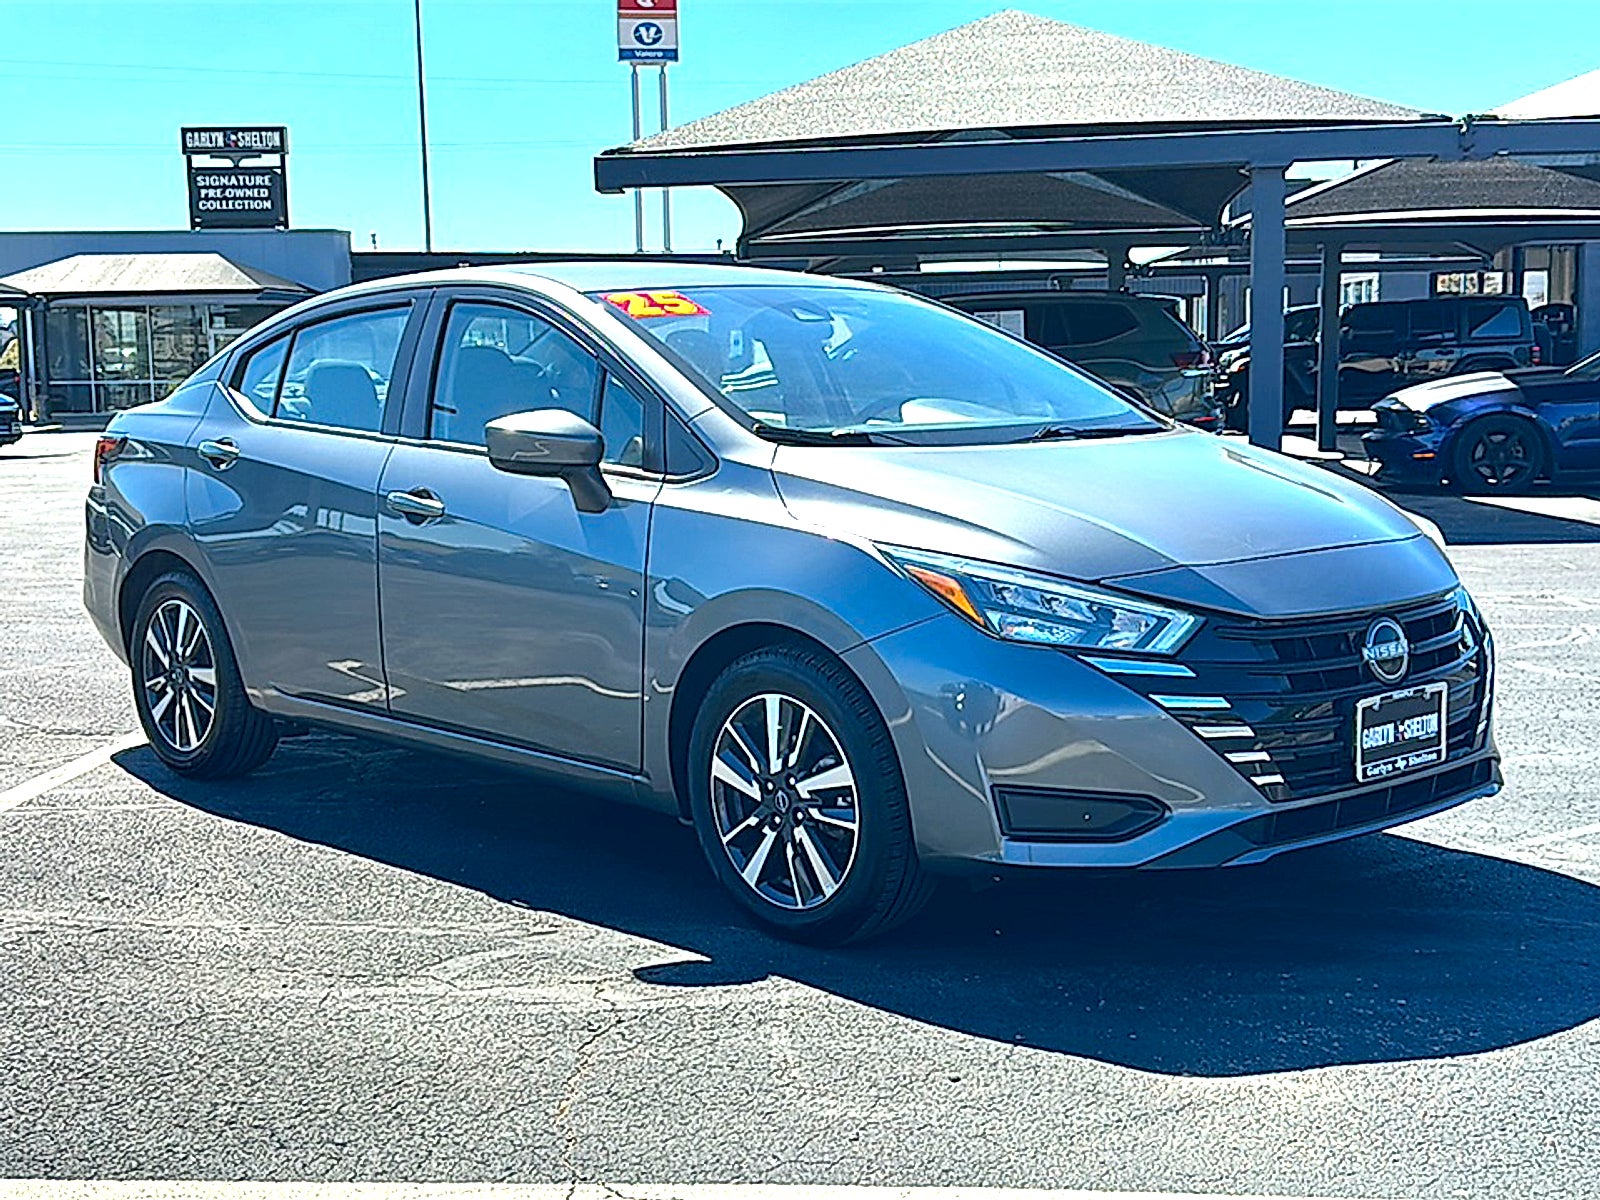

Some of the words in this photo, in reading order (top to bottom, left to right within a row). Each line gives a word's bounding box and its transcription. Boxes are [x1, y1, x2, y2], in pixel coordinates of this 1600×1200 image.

[237, 131, 281, 148] SHELTON
[196, 174, 272, 187] SIGNATURE
[198, 200, 272, 210] COLLECTION
[606, 290, 699, 315] 25
